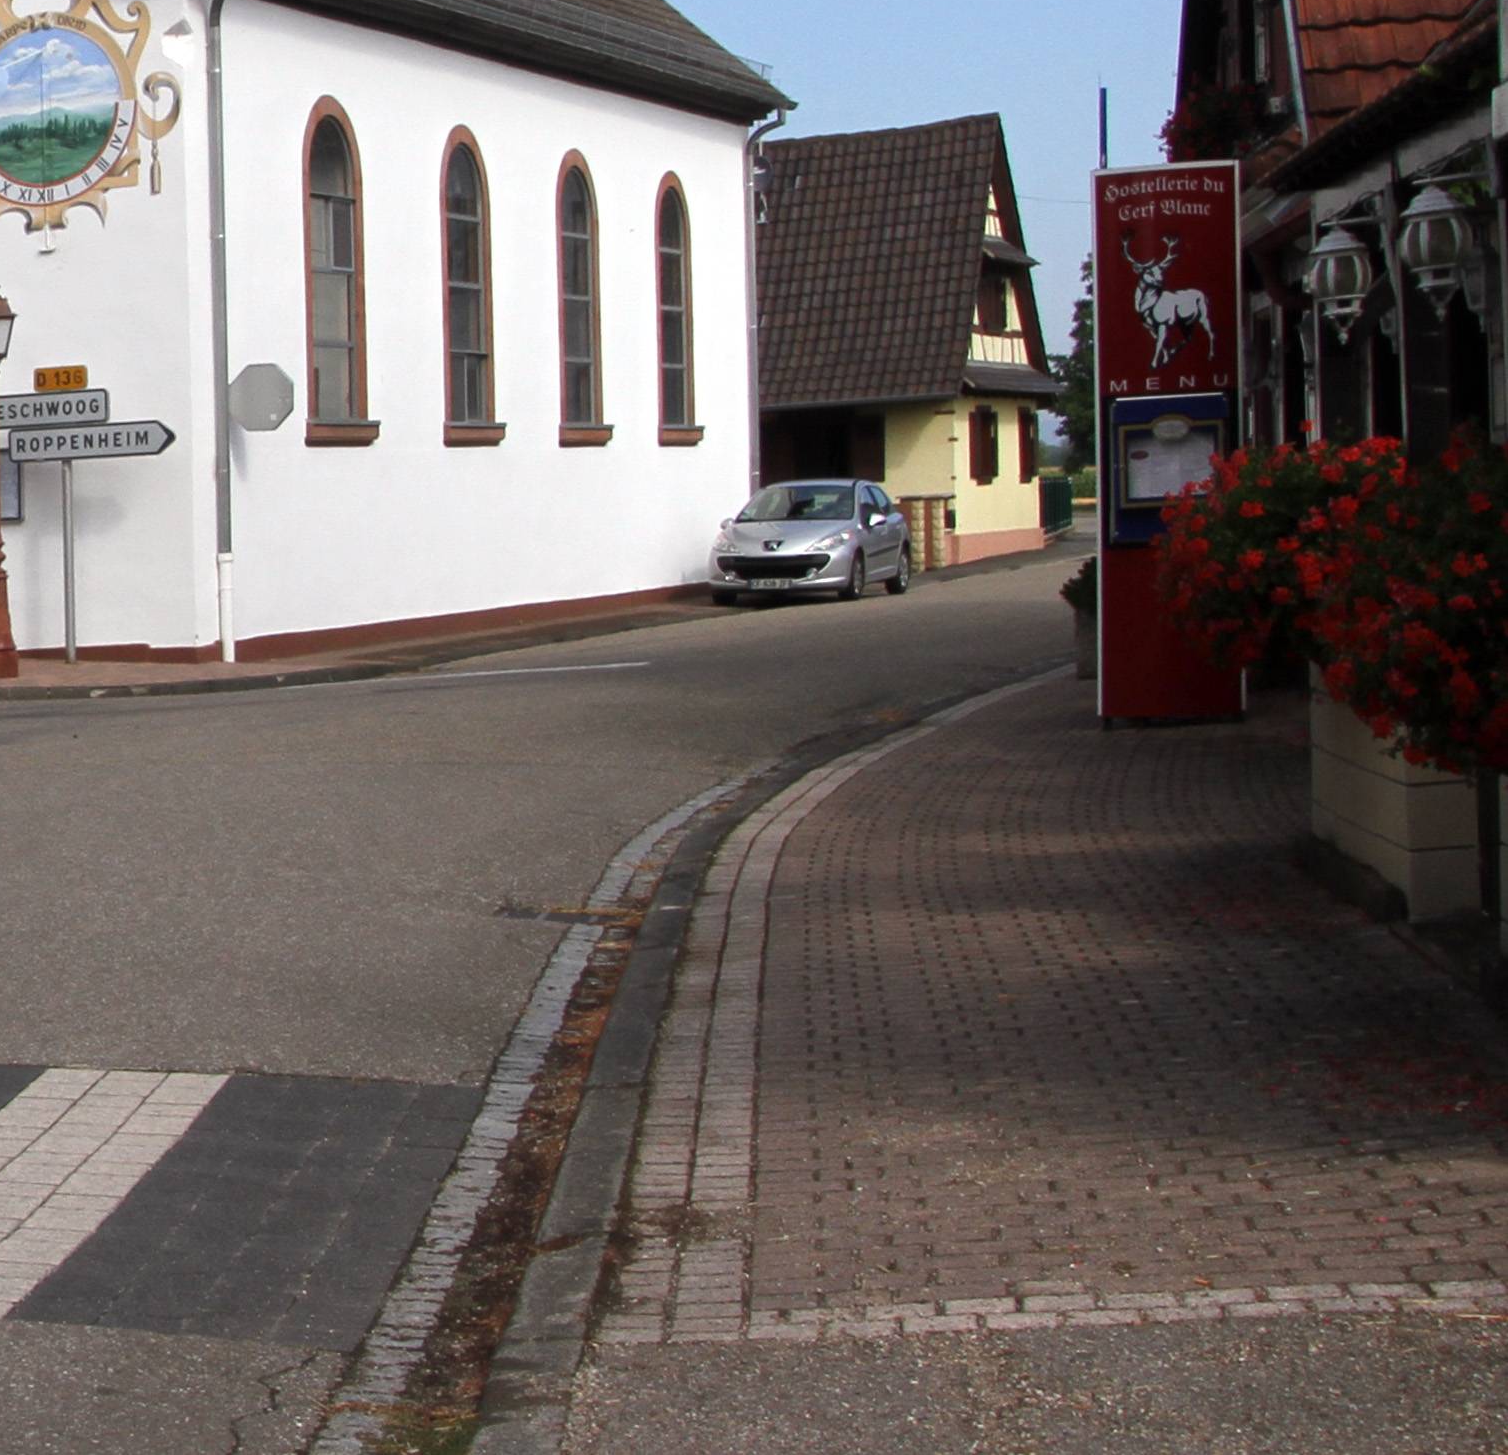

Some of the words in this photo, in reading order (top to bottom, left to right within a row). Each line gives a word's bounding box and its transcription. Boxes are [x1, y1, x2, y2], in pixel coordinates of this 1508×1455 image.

[0, 180, 12, 197] X
[1203, 176, 1225, 193] du
[18, 188, 32, 202] XI
[37, 188, 54, 202] XII
[1118, 200, 1156, 222] Cerf
[1160, 198, 1212, 217] Blanc
[36, 373, 47, 387] D
[54, 370, 84, 386] 136
[1109, 374, 1229, 393] MENU
[16, 430, 150, 453] ROPPENHEIM
